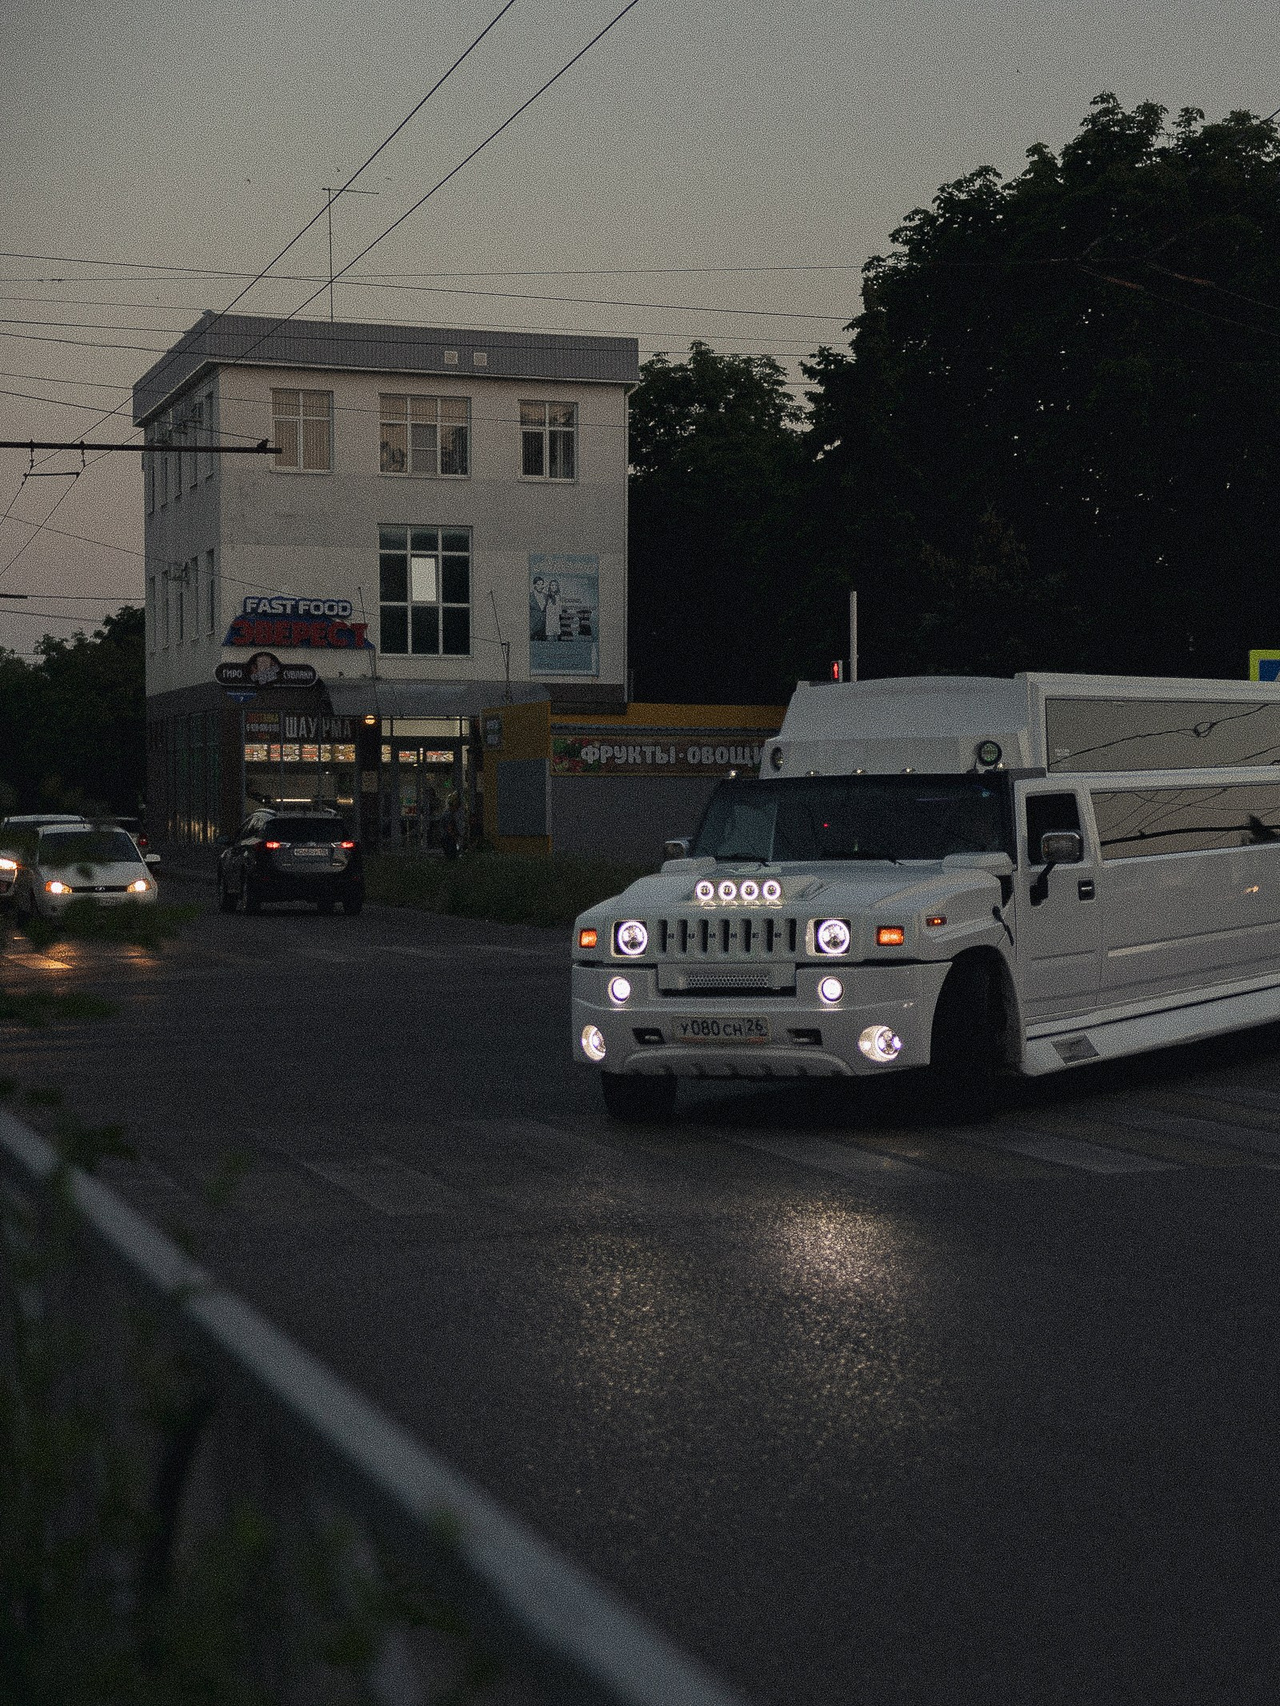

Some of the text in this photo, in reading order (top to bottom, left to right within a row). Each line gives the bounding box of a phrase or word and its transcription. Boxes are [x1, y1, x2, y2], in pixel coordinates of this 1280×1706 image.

[245, 599, 351, 617] FAST FOOD
[232, 619, 368, 648] ЭВЕРЕСТ
[580, 745, 676, 764] ФРУКТЫ
[747, 1019, 763, 1032] 26
